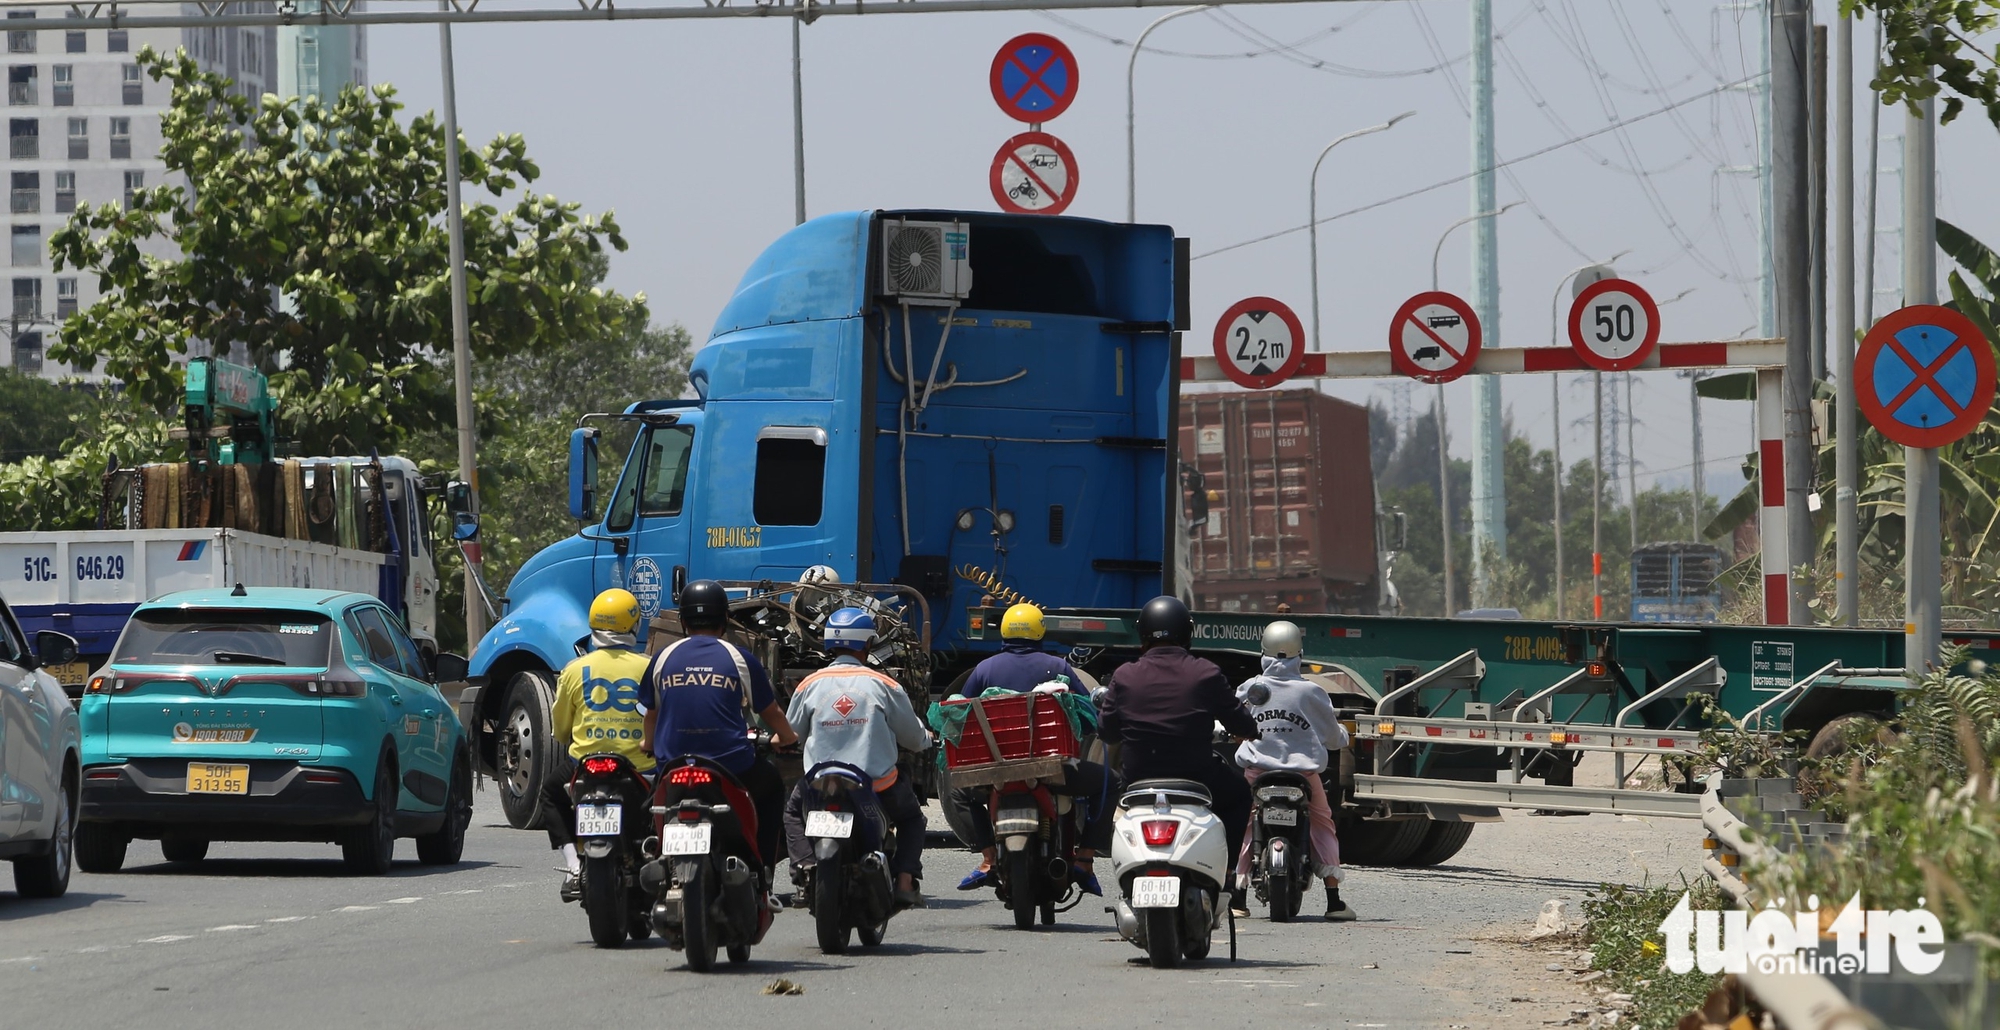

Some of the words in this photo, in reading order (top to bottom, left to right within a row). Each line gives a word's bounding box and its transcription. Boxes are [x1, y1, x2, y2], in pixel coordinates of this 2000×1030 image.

[1595, 304, 1635, 343] 50
[706, 526, 761, 548] 78H-016.57
[76, 555, 124, 581] 646.29
[54, 663, 75, 674] 51C
[582, 665, 641, 712] be
[661, 673, 738, 692] HEAVEN
[194, 730, 218, 742] 1900
[218, 731, 245, 742] 2088
[205, 765, 232, 778] 50H
[193, 778, 241, 792] 313.95
[579, 821, 619, 833] 835.06
[1141, 880, 1172, 892] 60-H1
[1136, 893, 1176, 905] 198.92
